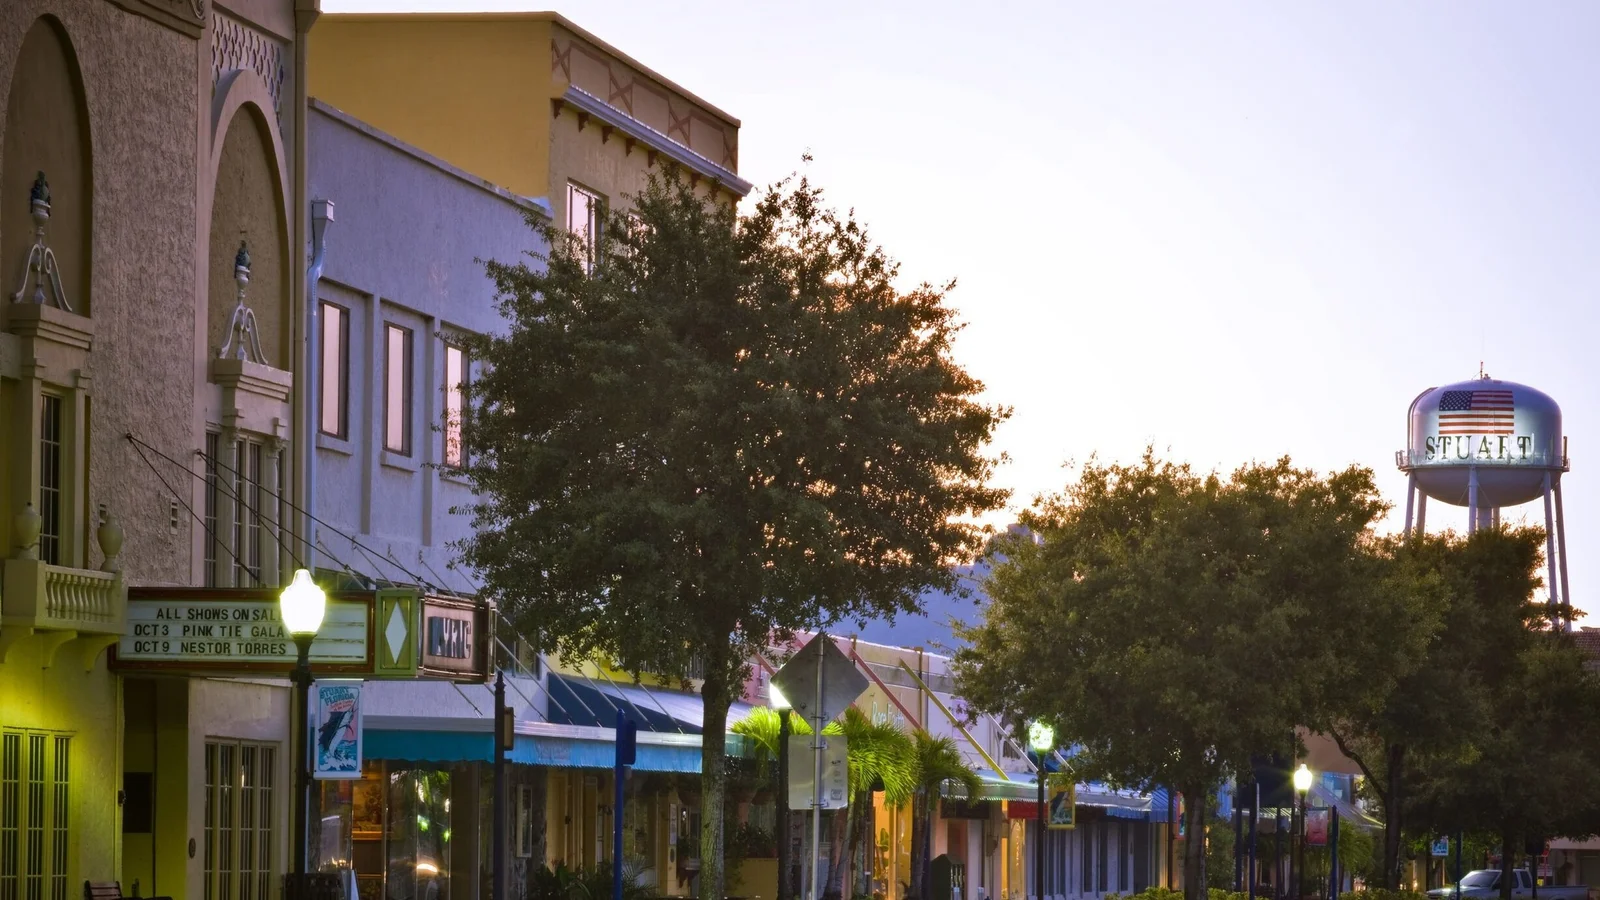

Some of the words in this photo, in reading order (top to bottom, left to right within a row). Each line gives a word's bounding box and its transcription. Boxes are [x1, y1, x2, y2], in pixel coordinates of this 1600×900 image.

[156, 608, 181, 620] ALL
[187, 608, 229, 620] SHOWS
[232, 609, 249, 620] ON
[134, 624, 159, 636] OCT
[162, 625, 169, 636] 3
[182, 625, 213, 637] PINK
[220, 626, 242, 637] TIE
[251, 626, 285, 638] GALA
[134, 641, 159, 653] OCT
[162, 641, 170, 653] 9
[180, 642, 231, 654] NESTOR
[236, 643, 286, 655] TORRES
